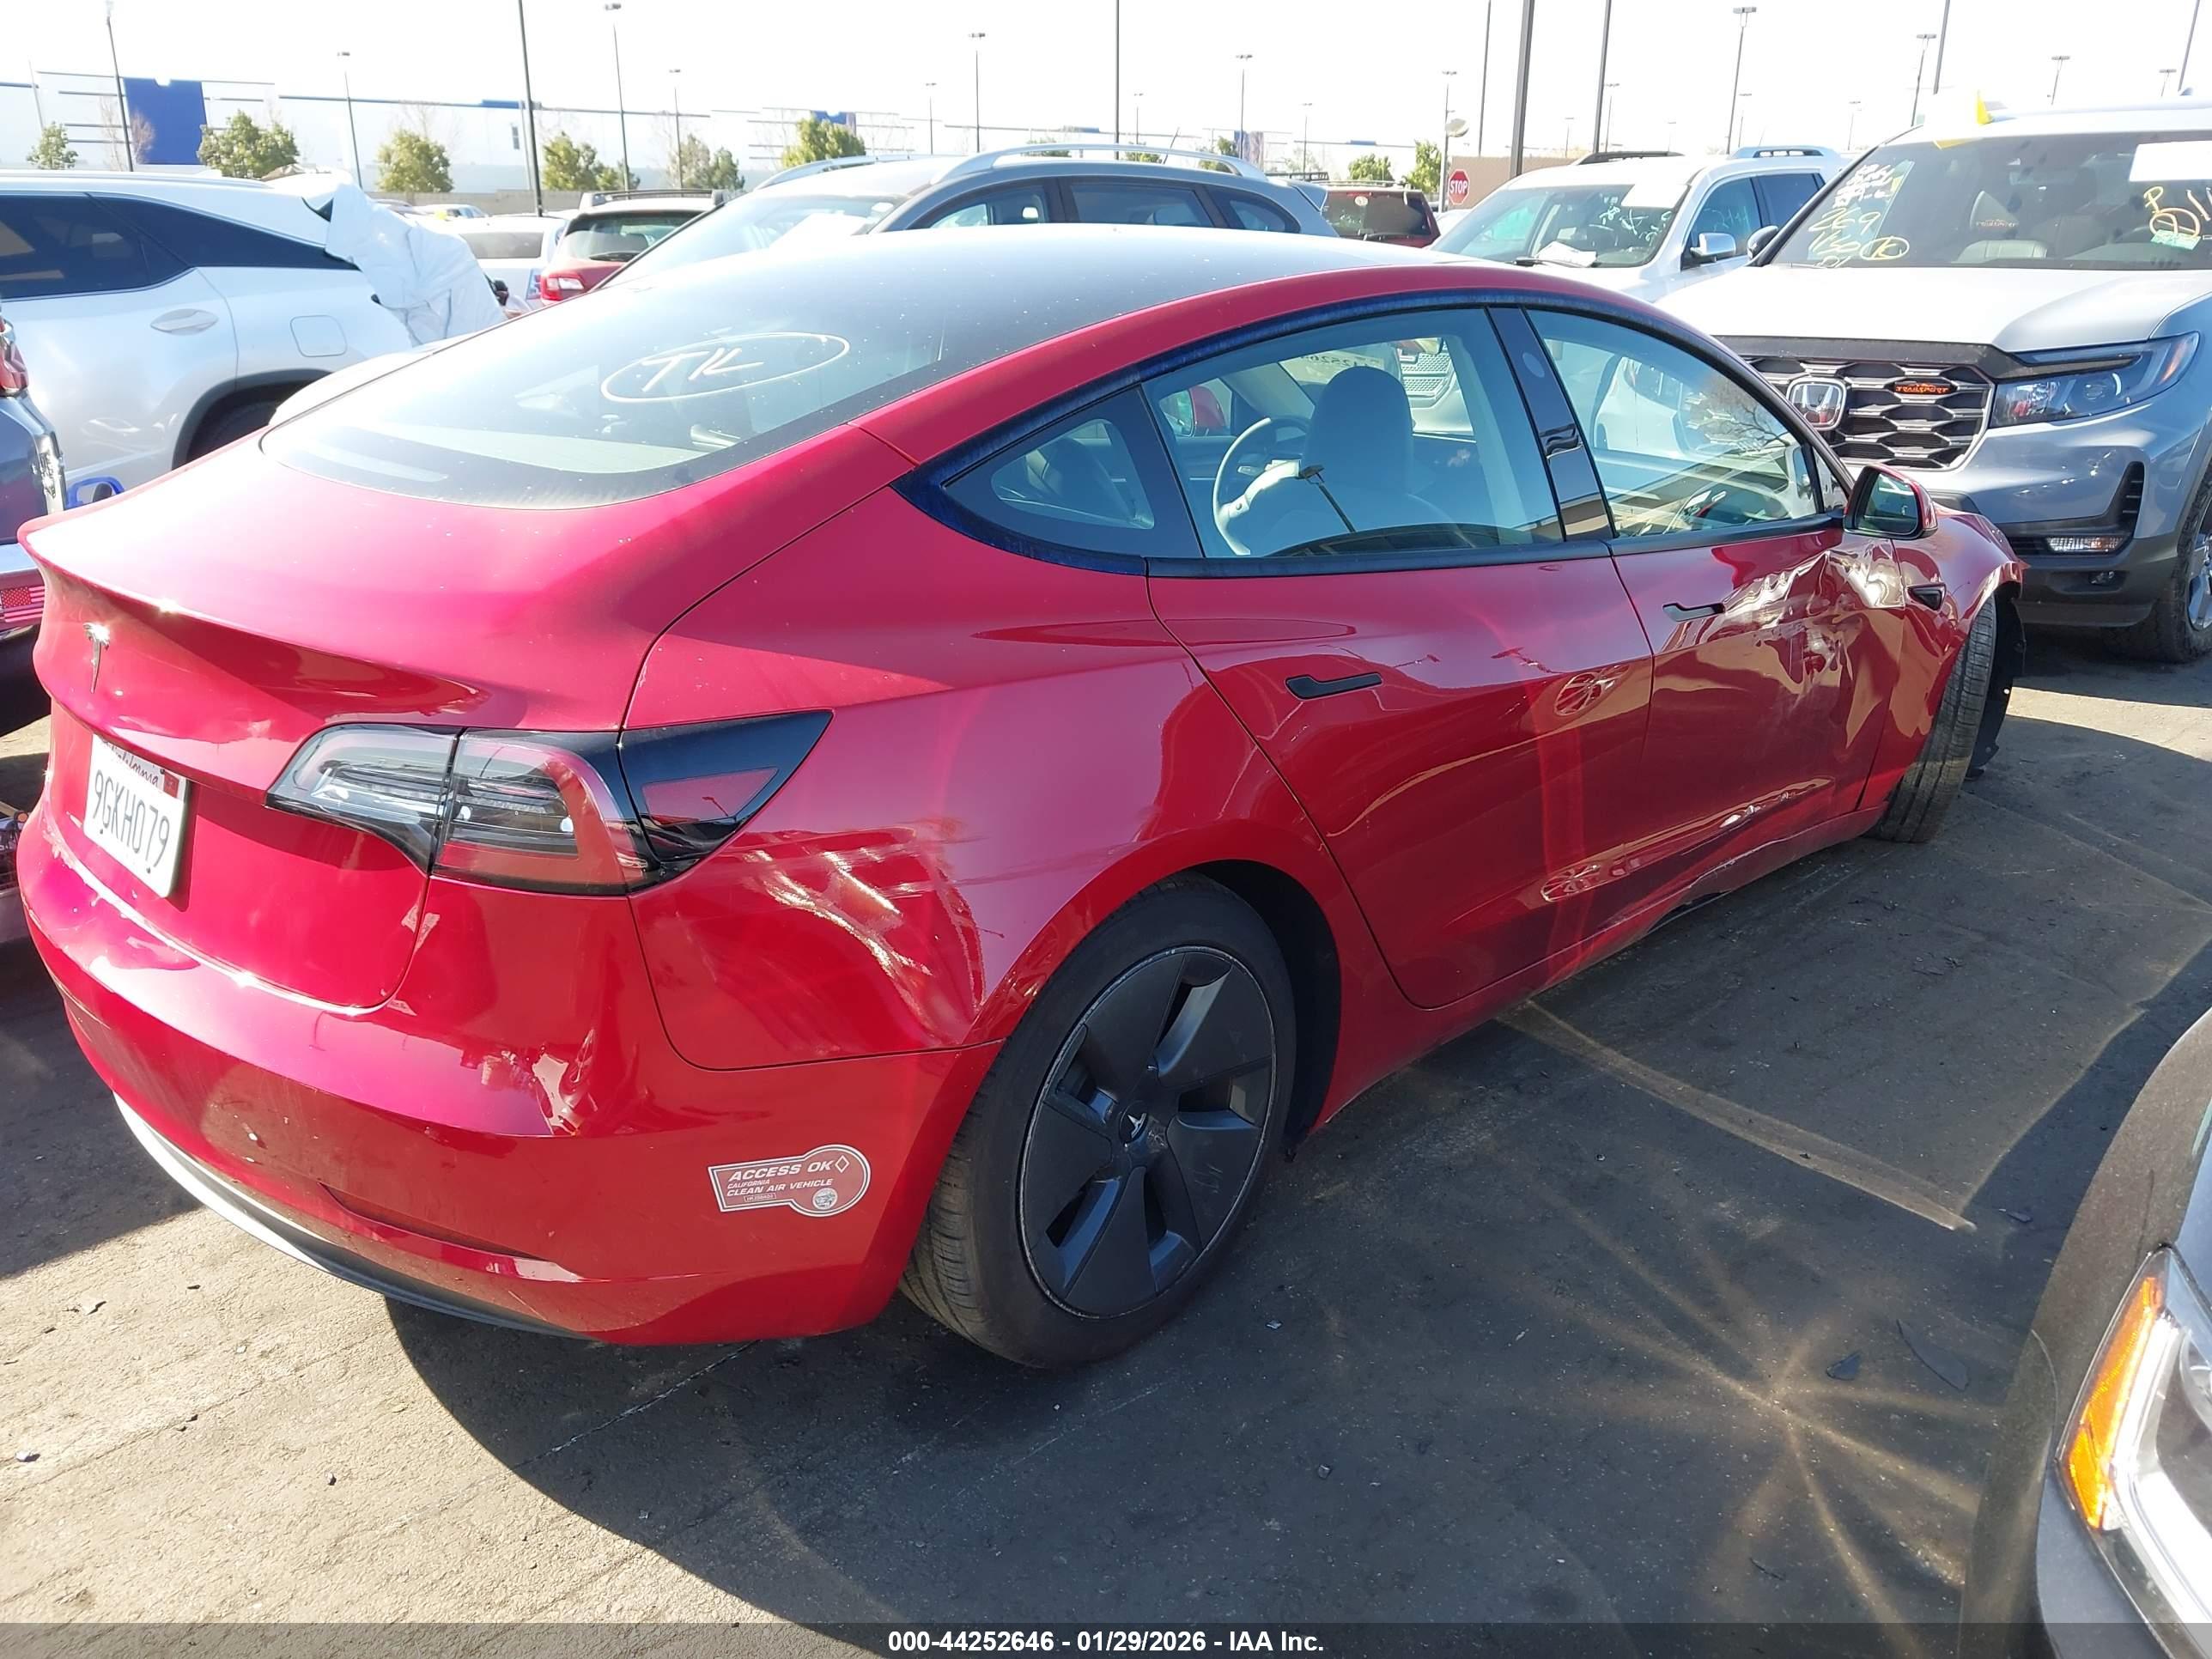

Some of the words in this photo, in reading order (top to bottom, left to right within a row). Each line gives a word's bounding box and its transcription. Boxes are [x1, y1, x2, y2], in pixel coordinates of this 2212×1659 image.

[1450, 179, 1468, 194] STOP
[93, 769, 170, 868] 9GKH079
[728, 1164, 802, 1182] ACCESS
[807, 1160, 834, 1173] OK
[726, 1186, 763, 1197] CLEAN
[790, 1178, 834, 1190] VEHICLE
[727, 1179, 770, 1189] CALIFORNIA
